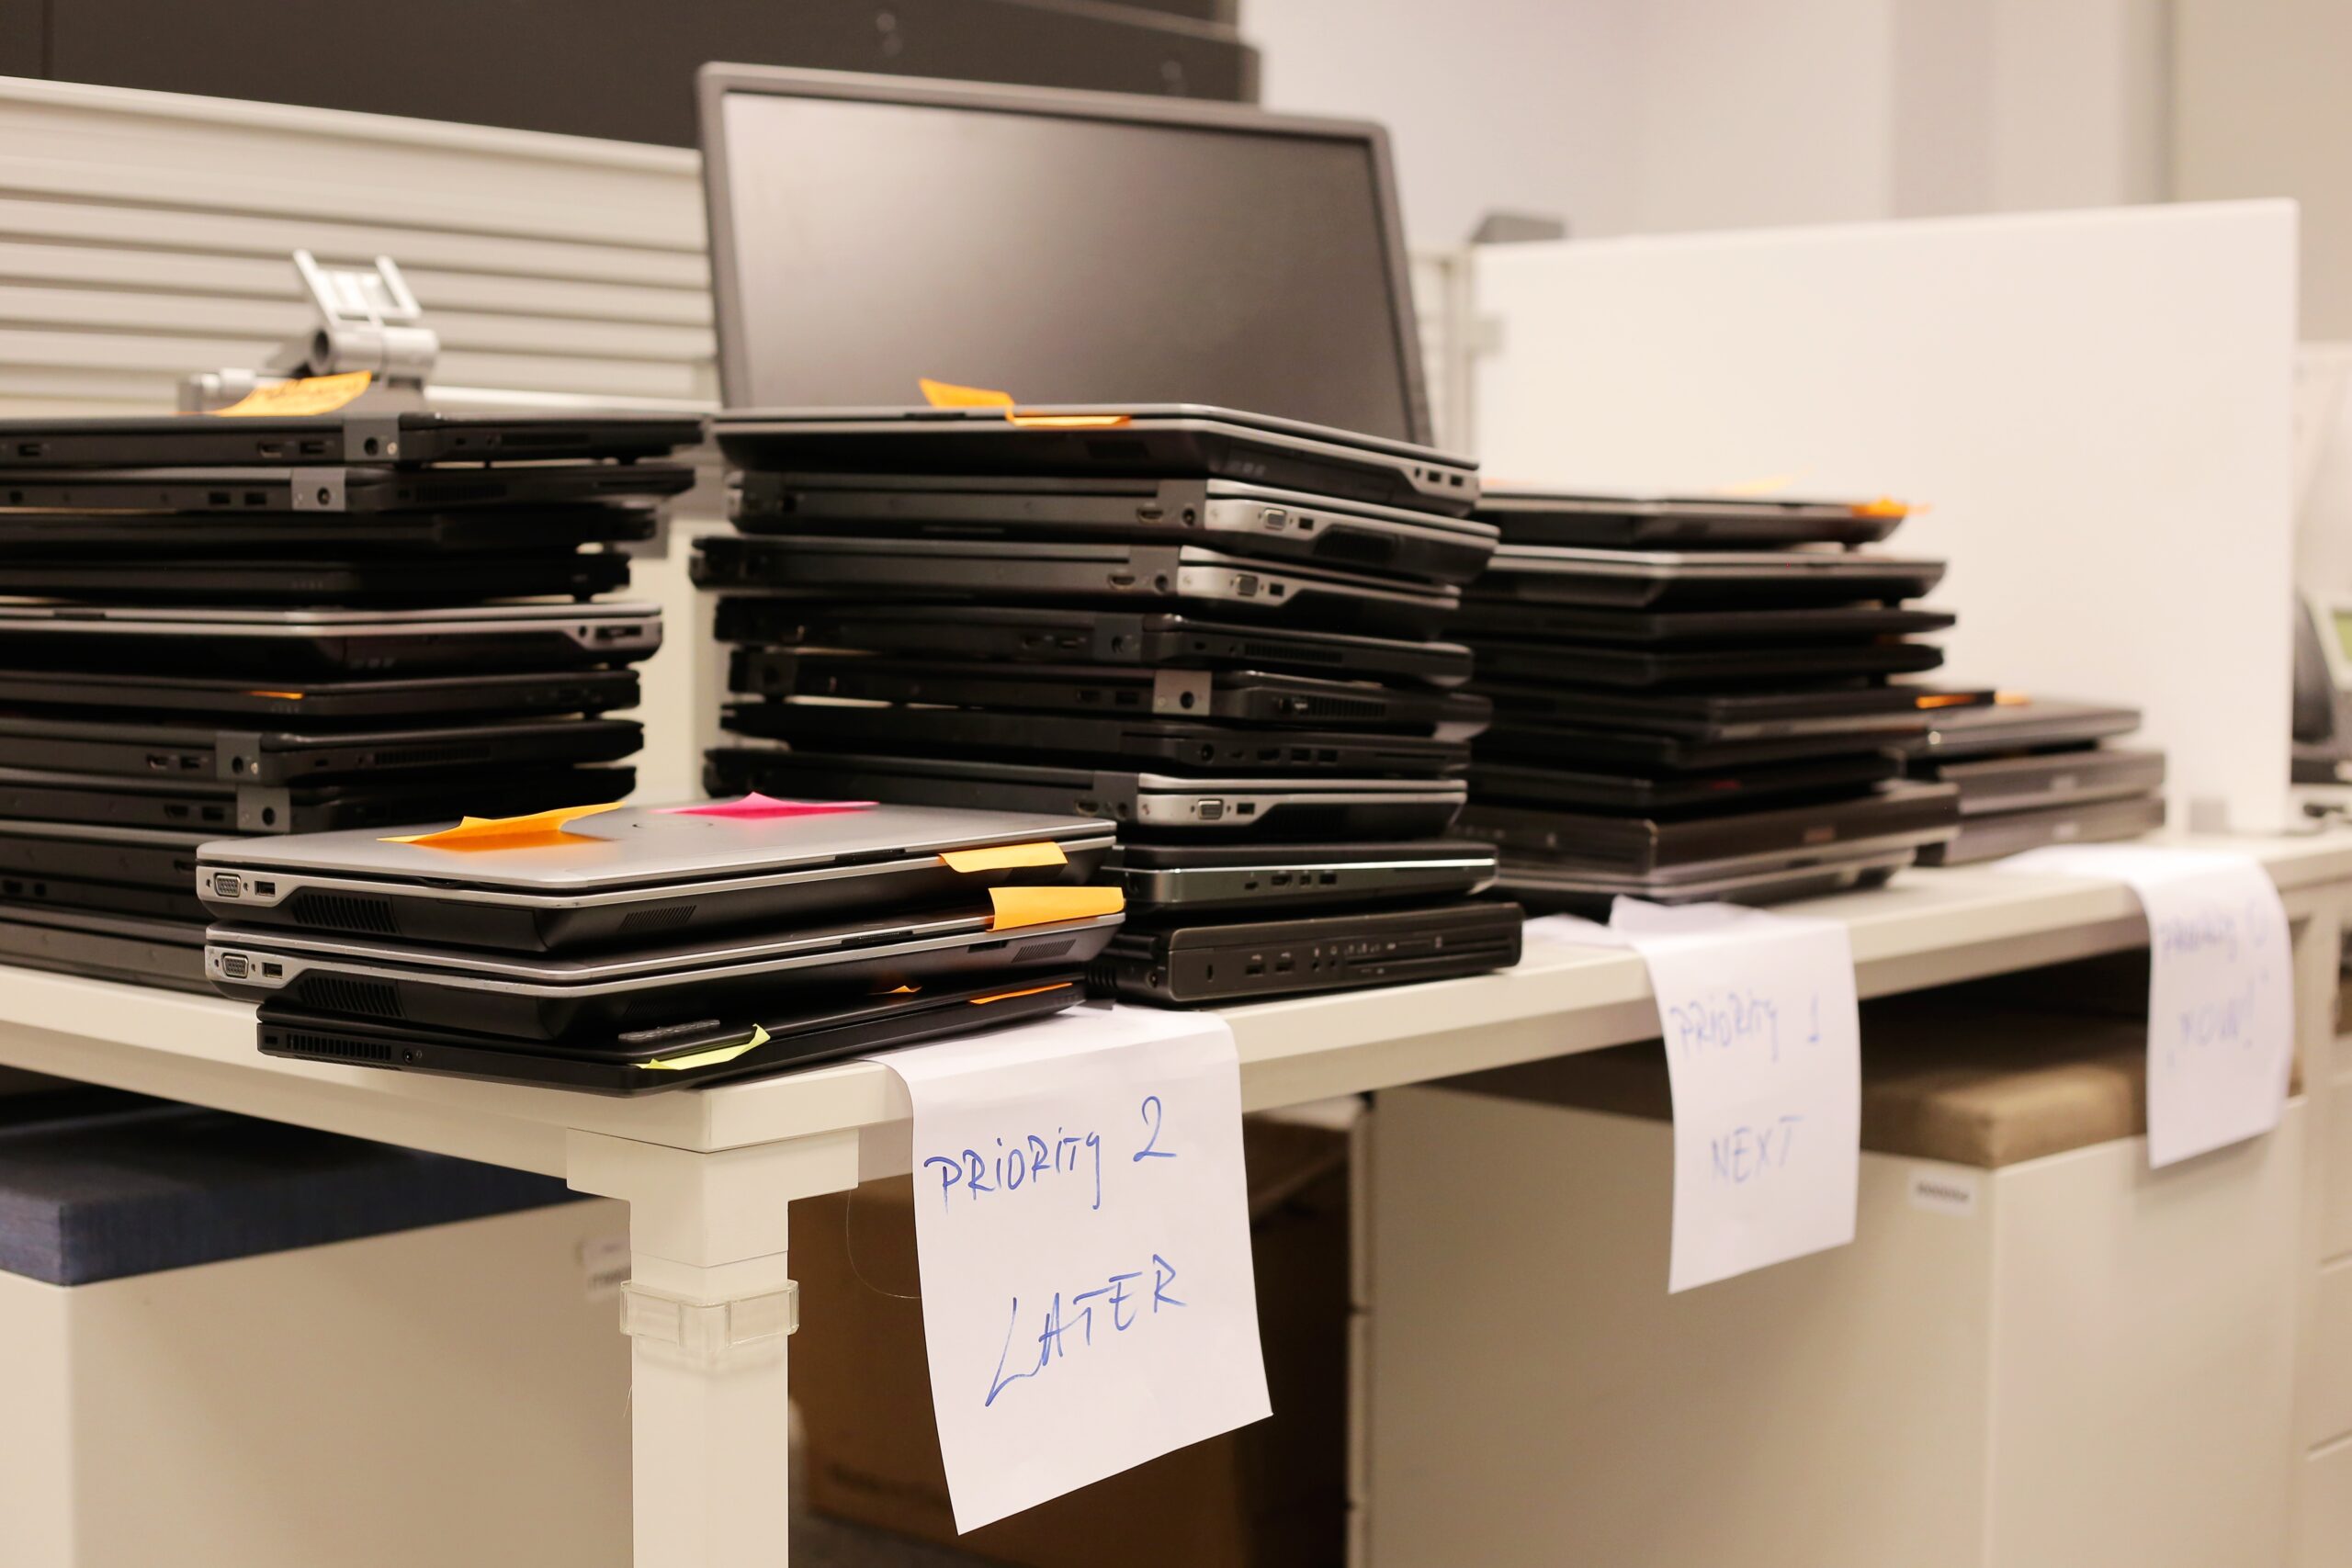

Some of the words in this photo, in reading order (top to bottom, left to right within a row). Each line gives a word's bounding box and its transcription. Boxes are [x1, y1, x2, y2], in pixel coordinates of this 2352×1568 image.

[1132, 1095, 1178, 1163] 2
[1711, 1114, 1806, 1184] NEXT
[985, 1254, 1188, 1408] LATER
